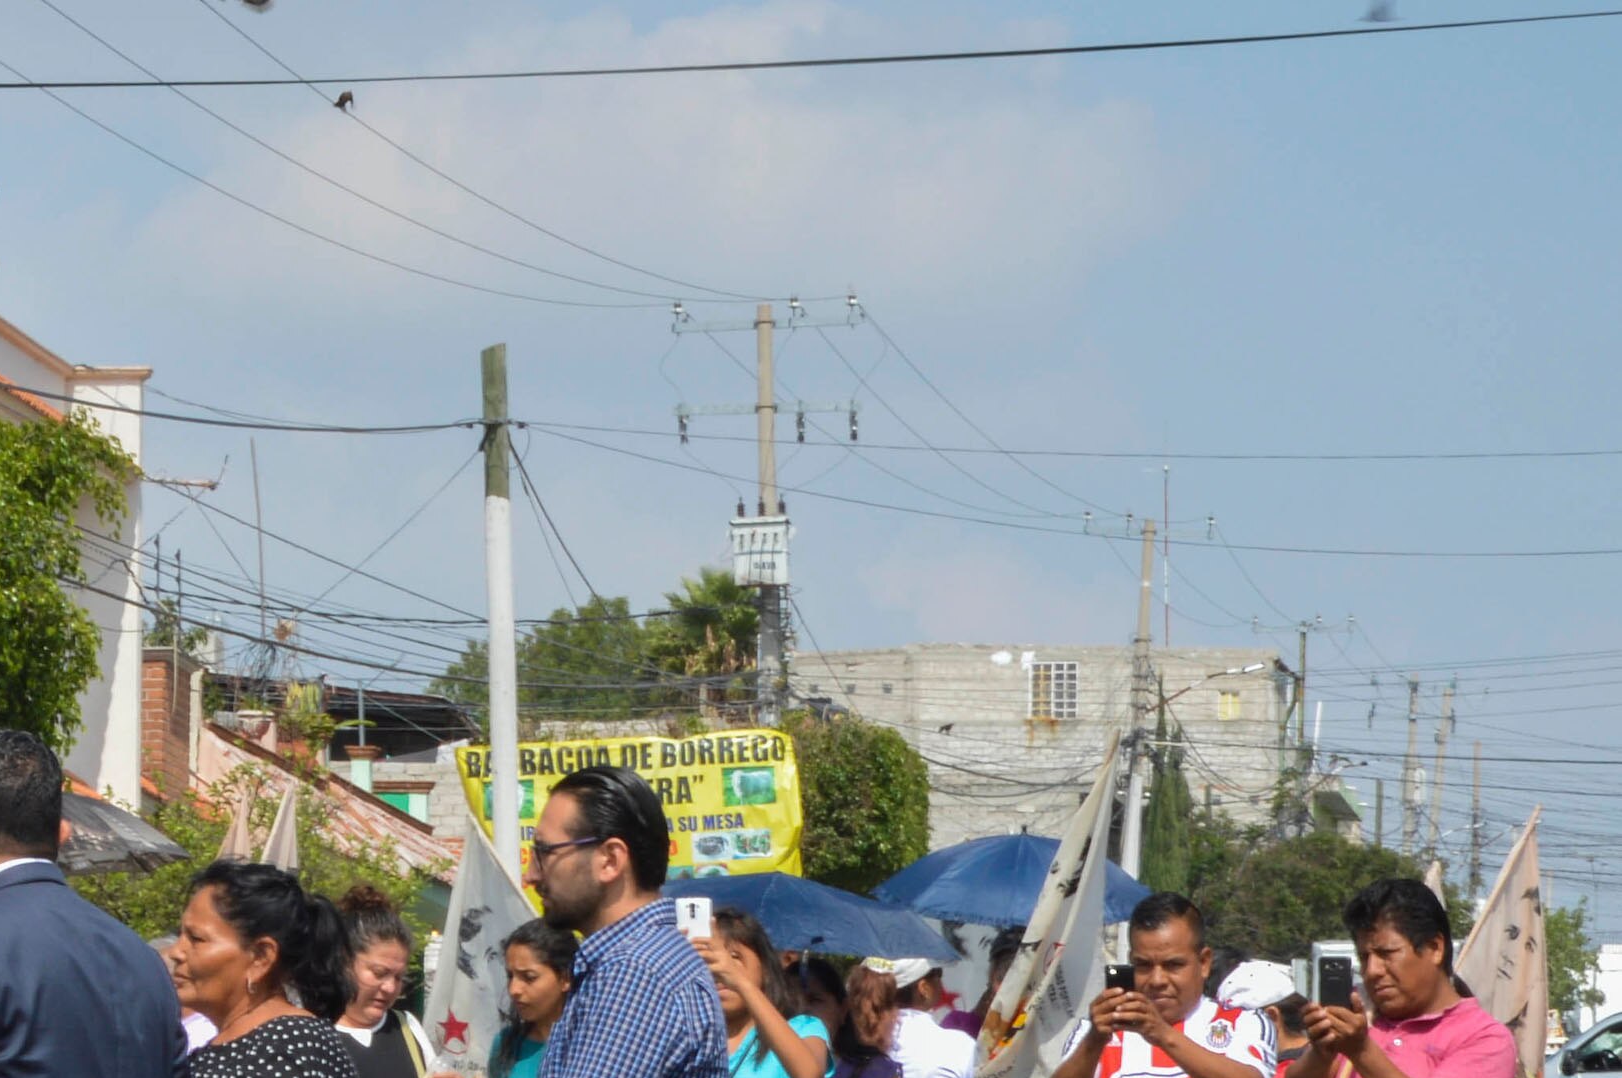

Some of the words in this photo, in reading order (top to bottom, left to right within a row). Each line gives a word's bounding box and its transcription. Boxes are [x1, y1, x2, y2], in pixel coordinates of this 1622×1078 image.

[620, 743, 653, 770] DE
[661, 734, 786, 768] BORREGO
[678, 816, 698, 832] SU
[702, 813, 745, 831] MESA
